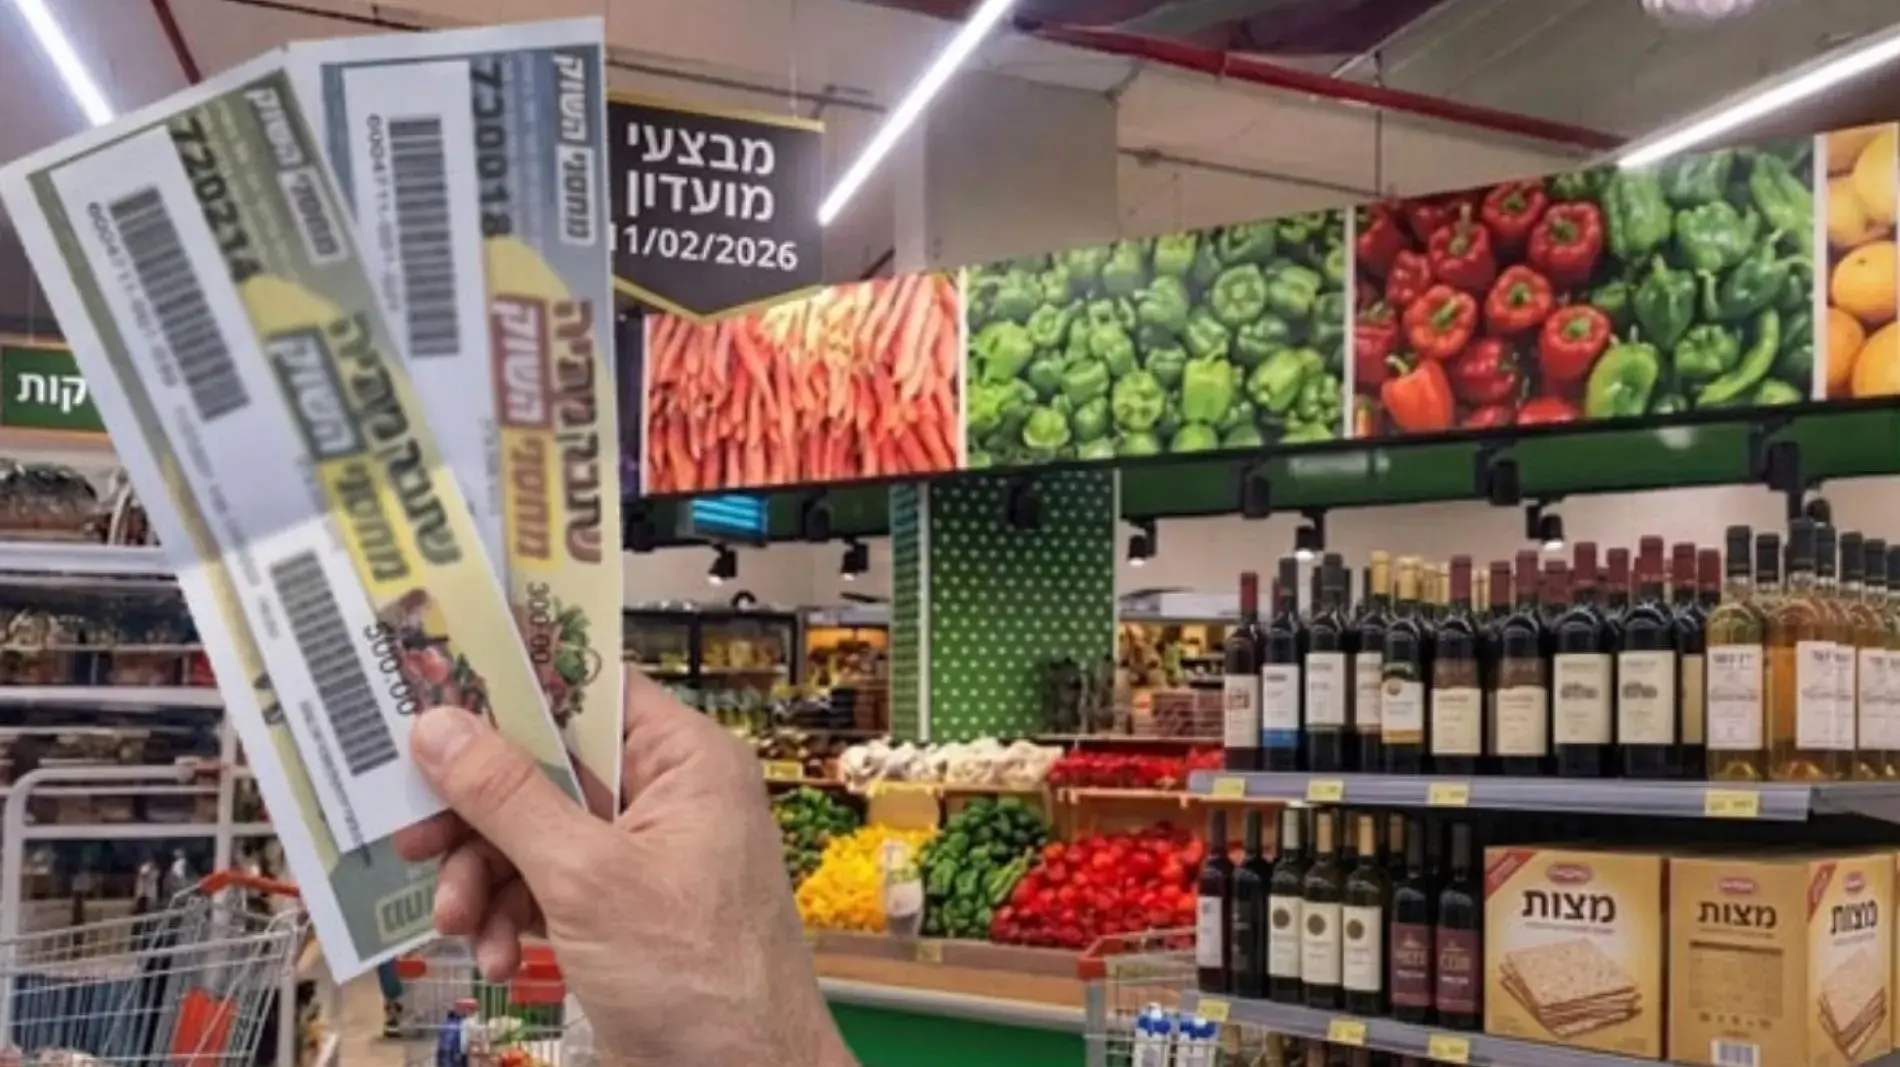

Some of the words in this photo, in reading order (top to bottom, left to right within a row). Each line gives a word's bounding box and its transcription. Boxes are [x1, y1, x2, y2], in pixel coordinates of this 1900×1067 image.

[553, 53, 588, 142] השוק
[627, 121, 775, 176] מבצעי
[627, 170, 775, 222] מועדון
[610, 222, 798, 271] 11/02/2026
[268, 335, 360, 455] השוק
[496, 300, 544, 424] השוק
[336, 463, 411, 583] מחסני
[512, 439, 551, 561] מחסני
[527, 581, 554, 666] 300.00
[360, 619, 423, 718] 500.00
[1521, 888, 1616, 924] מצות
[1697, 900, 1777, 930] מצות
[1830, 900, 1878, 936] מצות
